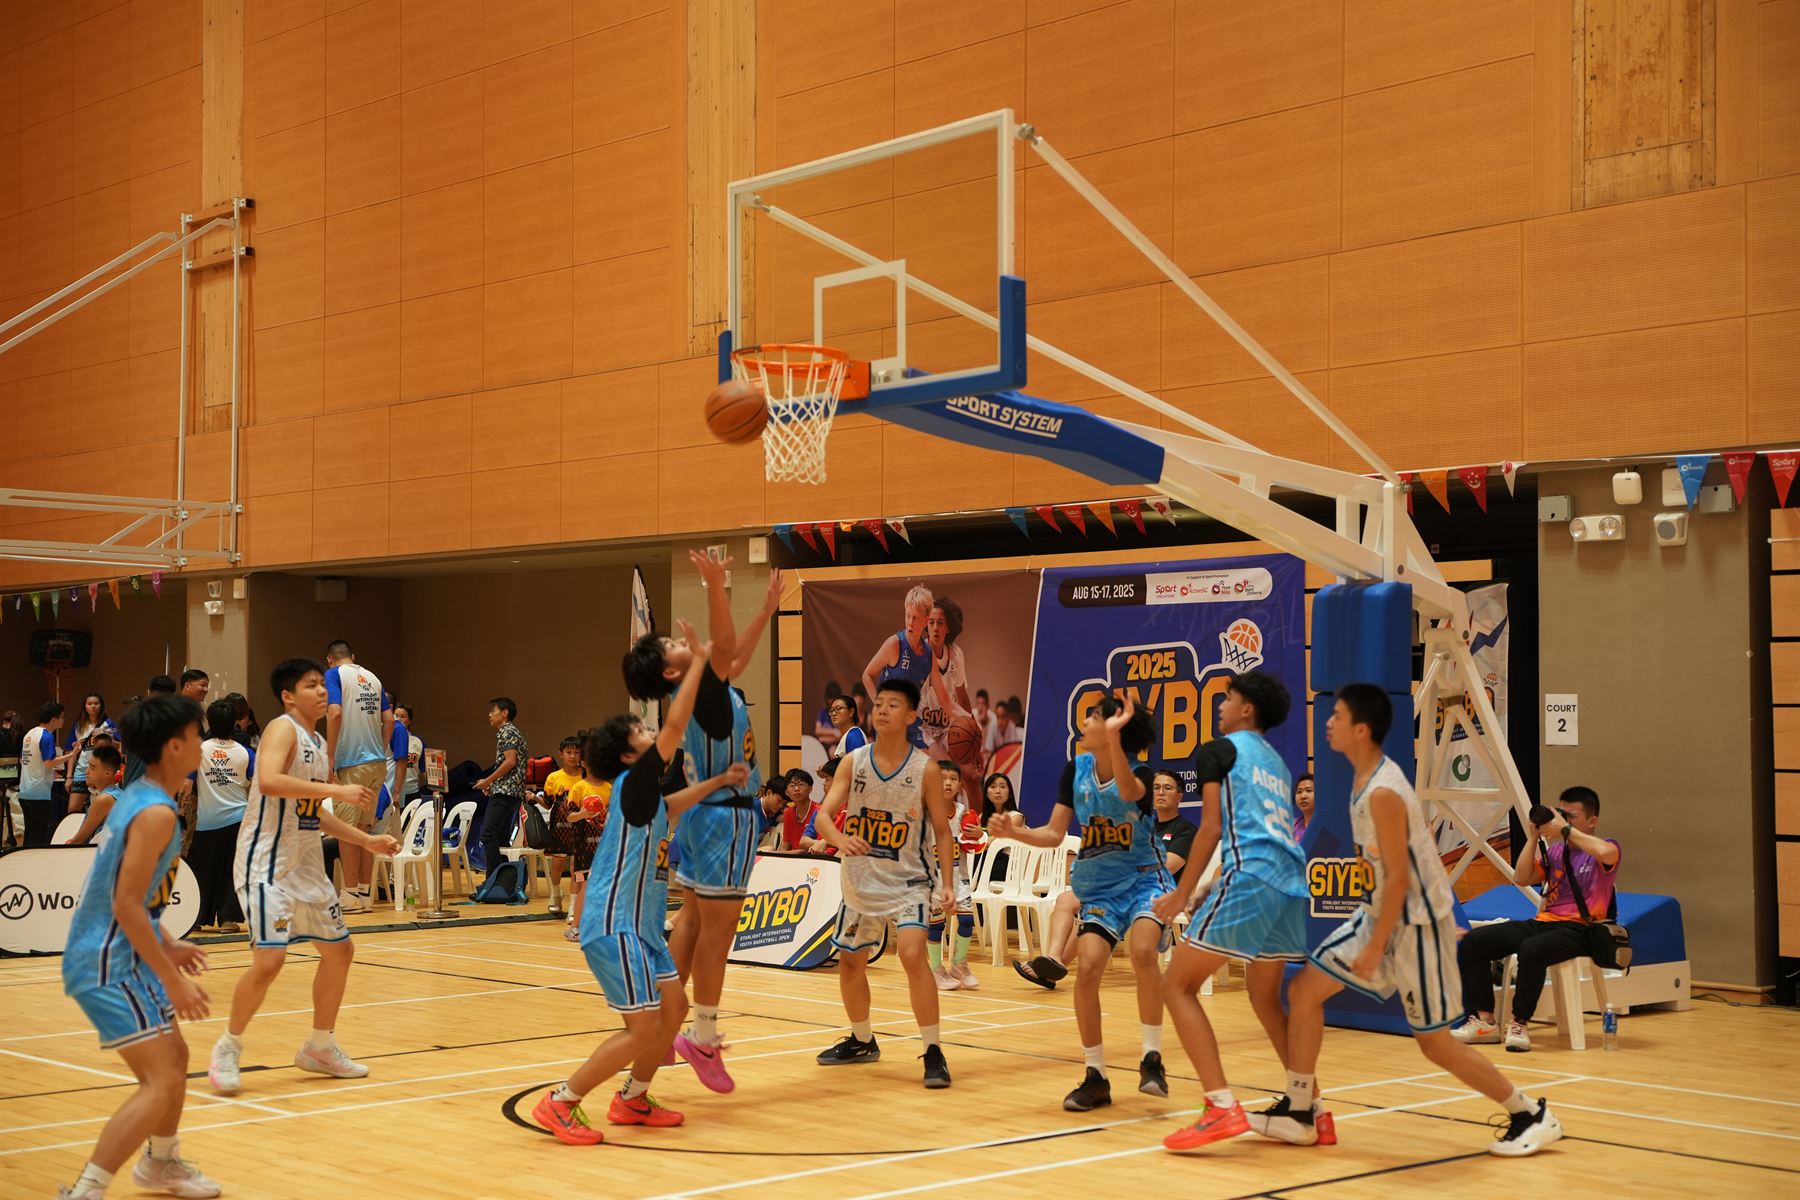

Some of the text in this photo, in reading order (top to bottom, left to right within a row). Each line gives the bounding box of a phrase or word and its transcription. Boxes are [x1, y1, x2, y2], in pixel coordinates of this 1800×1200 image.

[999, 406, 1063, 432] SYSTEM
[1073, 584, 1135, 600] AUG 15-17, 2025
[1155, 584, 1177, 595] Sport
[901, 658, 910, 670] 27
[1126, 651, 1176, 681] 2025
[1546, 704, 1577, 712] COURT
[1557, 718, 1567, 732] 2
[303, 749, 314, 764] 27
[1178, 770, 1198, 780] TION
[854, 779, 866, 793] 77
[1185, 782, 1198, 793] OP
[846, 816, 908, 849] SIYBO
[1310, 864, 1363, 897] SIYB
[328, 902, 341, 920] 27
[736, 886, 810, 932] SIYBO
[740, 928, 792, 941] STARLIGHT INTERNATIONAL
[753, 937, 778, 946] BASKETBALL
